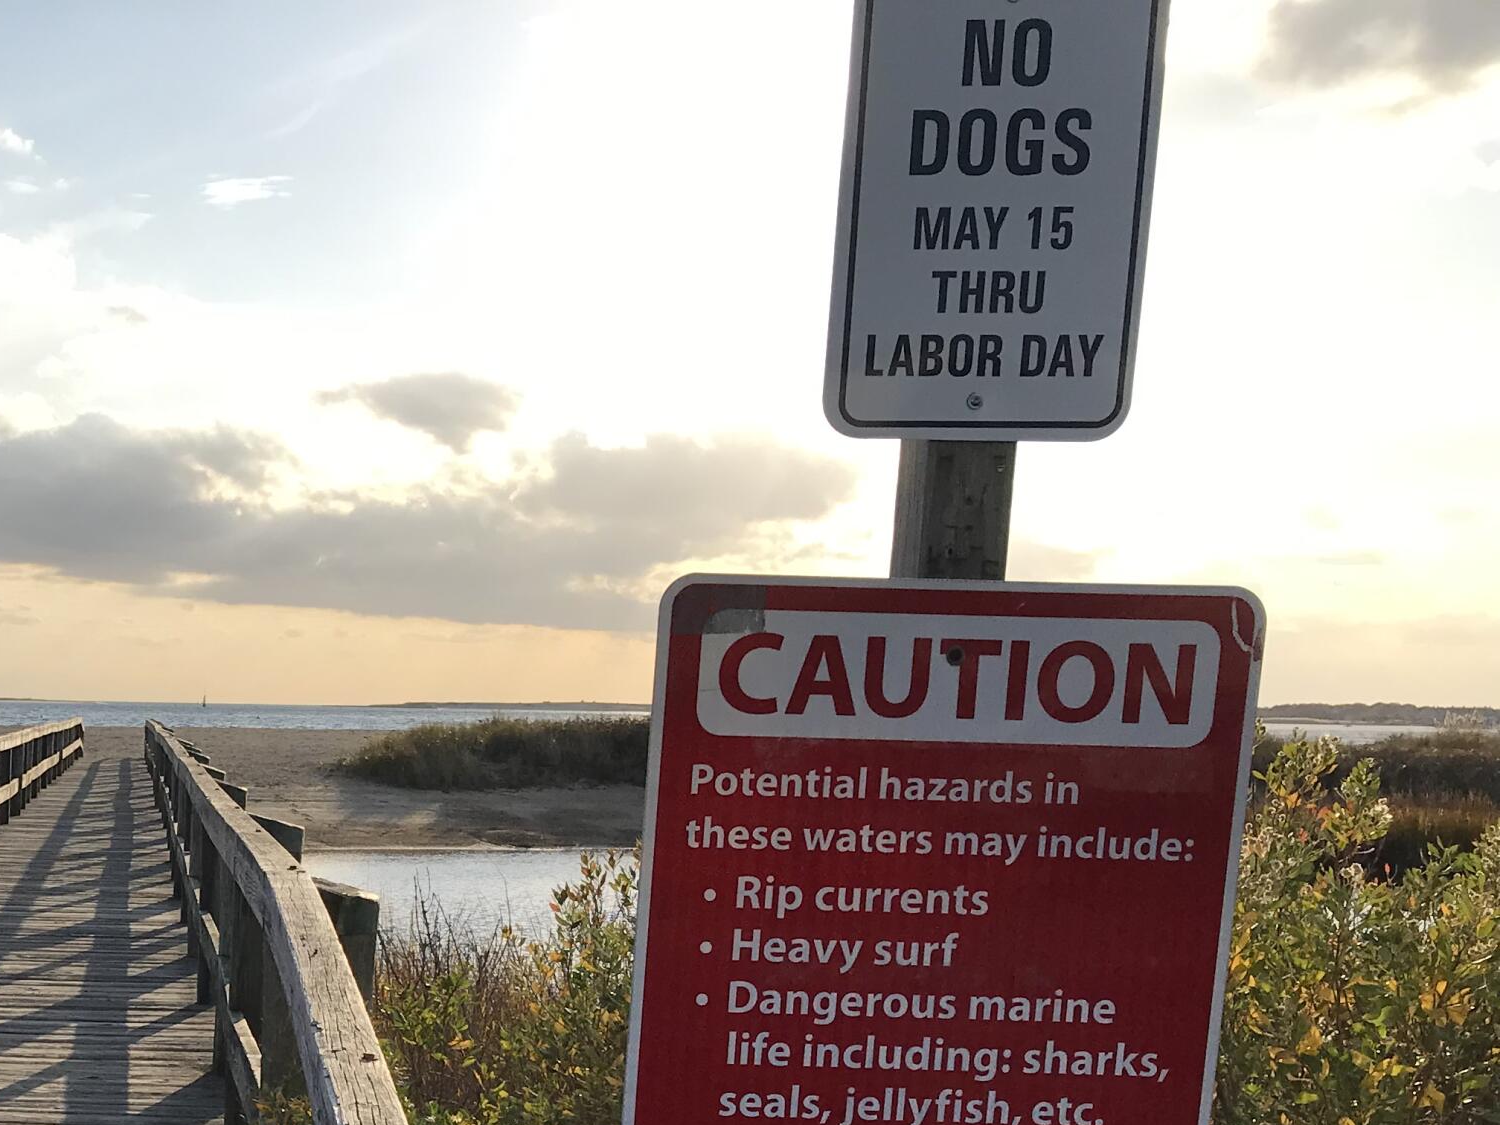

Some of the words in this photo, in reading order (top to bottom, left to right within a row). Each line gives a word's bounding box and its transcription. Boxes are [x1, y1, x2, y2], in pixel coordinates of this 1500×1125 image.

[961, 18, 1053, 87] NO
[908, 108, 1093, 176] DOGS
[913, 206, 1009, 250] MAY
[1027, 206, 1074, 250] 15
[932, 270, 1046, 314] THRU
[864, 334, 1003, 377] LABOR
[1019, 334, 1105, 377] DAY
[718, 632, 1197, 725] CAUTION
[690, 763, 868, 799] Potential
[879, 768, 1032, 803] hazards
[1044, 772, 1079, 805] in
[686, 816, 792, 850] these
[804, 825, 932, 855] waters
[944, 831, 1027, 866] may
[1037, 825, 1195, 862] include:
[735, 875, 803, 919] Rip
[815, 885, 989, 916] currents
[731, 928, 864, 974] Heavy
[874, 932, 959, 967] surf
[727, 980, 957, 1026] Dangerous
[968, 989, 1116, 1024] marine
[726, 1031, 791, 1066] life
[802, 1033, 1013, 1082] including:
[1022, 1040, 1170, 1083] sharks,
[718, 1084, 831, 1124] seals,
